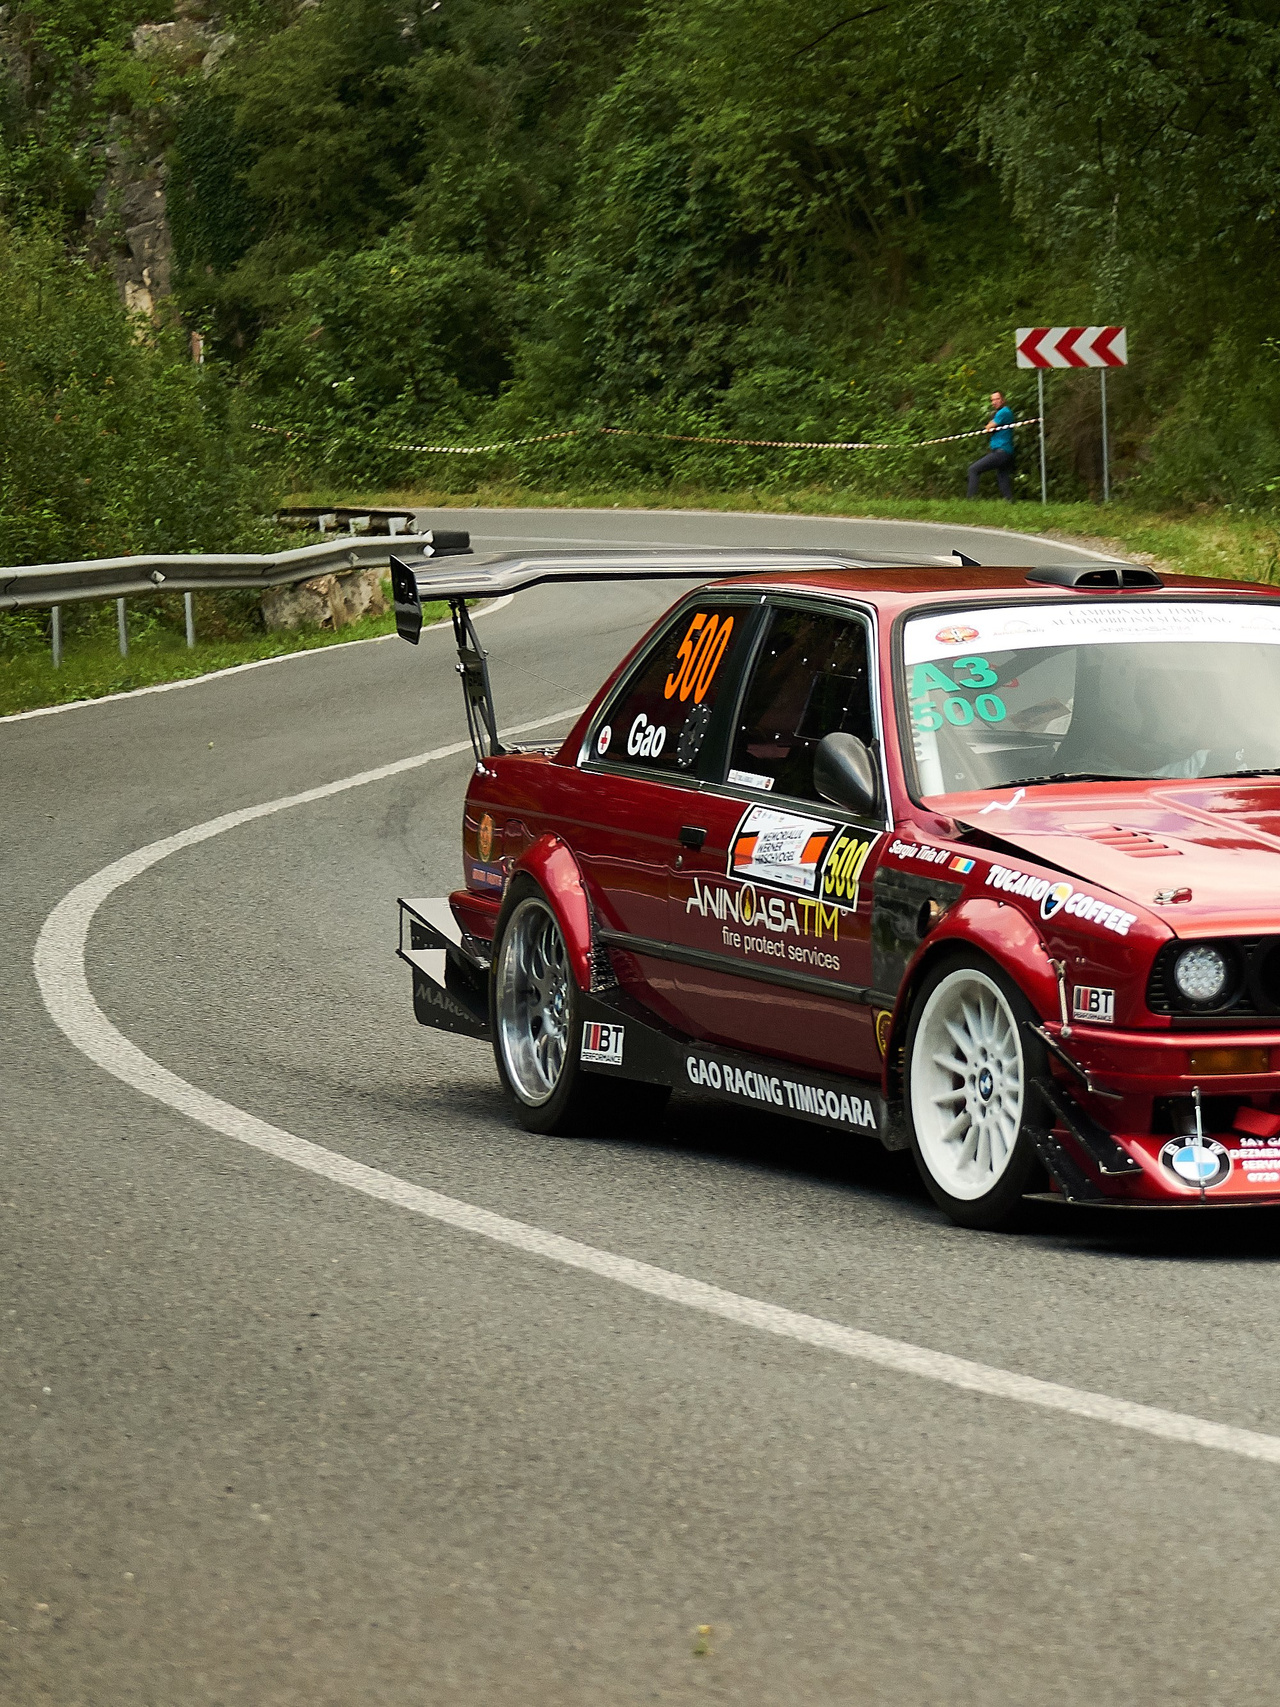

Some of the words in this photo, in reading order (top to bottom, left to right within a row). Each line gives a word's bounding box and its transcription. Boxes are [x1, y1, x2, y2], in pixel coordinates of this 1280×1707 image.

[665, 613, 734, 704] 500
[911, 656, 999, 698] A3
[913, 693, 1007, 732] 500
[627, 713, 667, 758] Gao
[757, 842, 784, 853] WERNER
[824, 836, 869, 900] 500
[888, 839, 919, 860] Sergiu
[985, 864, 1050, 902] TUCANO
[1064, 892, 1138, 936] COFFEE
[721, 926, 742, 948] fire
[743, 934, 786, 959] protect
[787, 943, 841, 971] services
[686, 1056, 723, 1090] GAO
[723, 1064, 784, 1106] RACING
[782, 1080, 877, 1130] TIMISOARA
[1165, 1137, 1225, 1156] BMW
